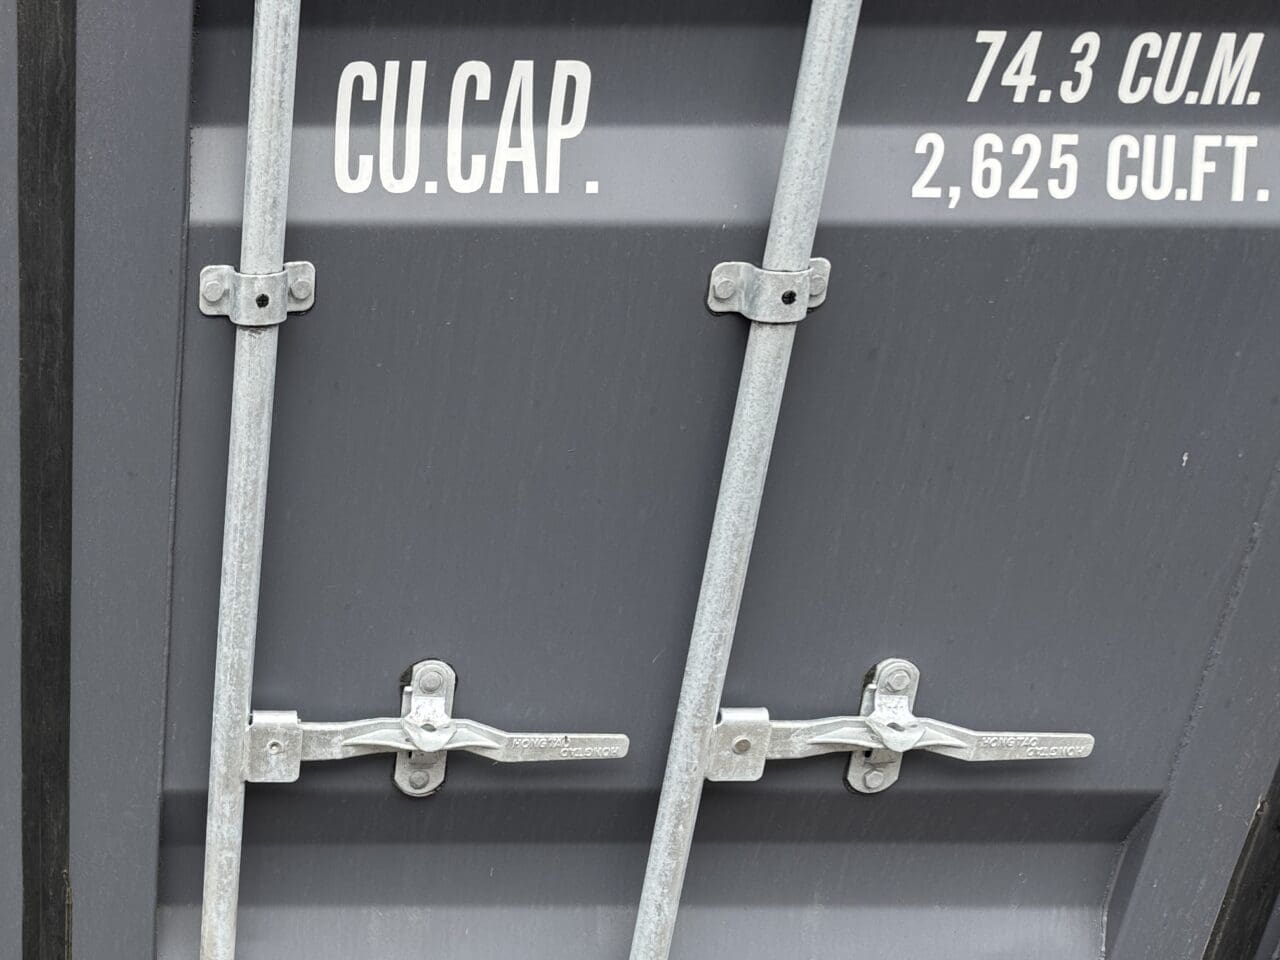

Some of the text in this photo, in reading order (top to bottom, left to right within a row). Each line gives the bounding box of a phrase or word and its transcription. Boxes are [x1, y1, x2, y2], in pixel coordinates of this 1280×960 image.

[967, 31, 1264, 105] 74.3 CU.M.
[334, 60, 599, 194] CU.CAP.
[911, 132, 1270, 209] 2,625 CU.FT.
